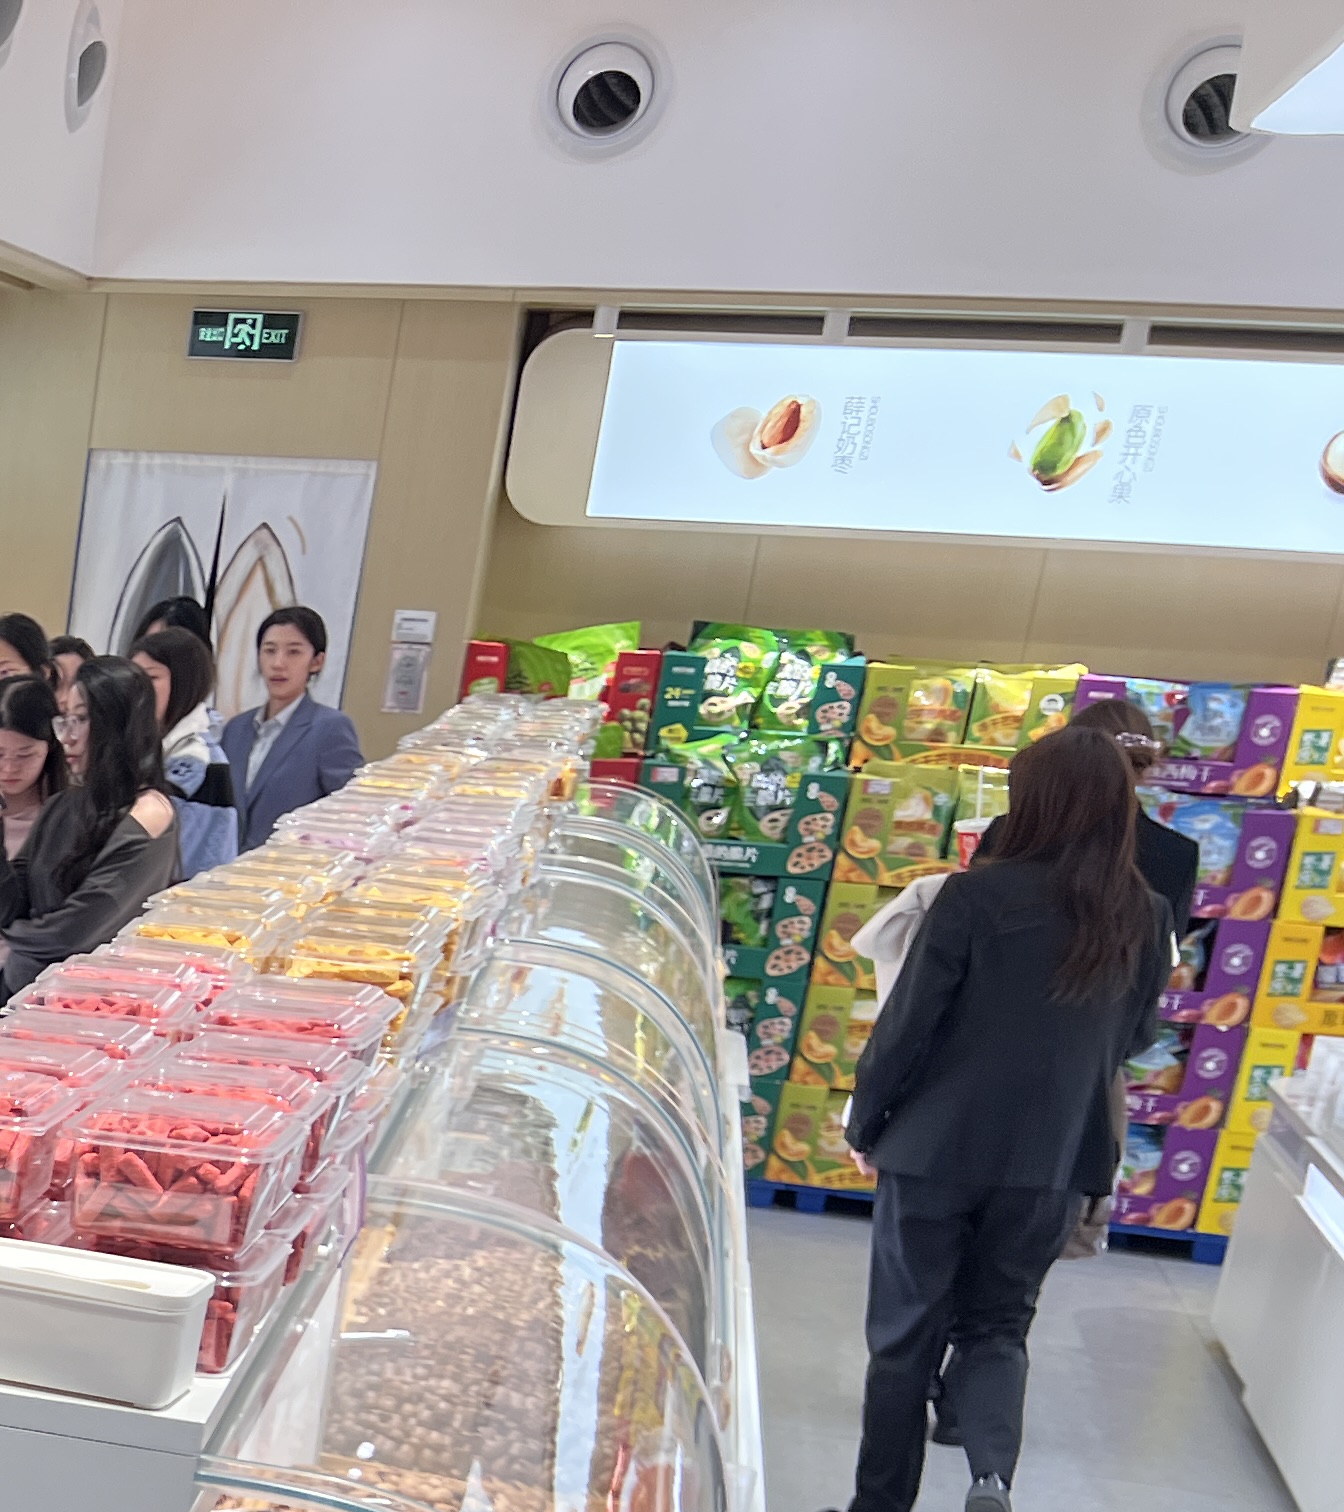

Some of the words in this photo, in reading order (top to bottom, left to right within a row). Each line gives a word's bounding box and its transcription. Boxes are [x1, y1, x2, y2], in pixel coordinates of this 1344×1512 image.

[262, 329, 289, 343] EXIT
[831, 396, 866, 475] 薛记奶枣
[1108, 404, 1154, 505] 原色开心果
